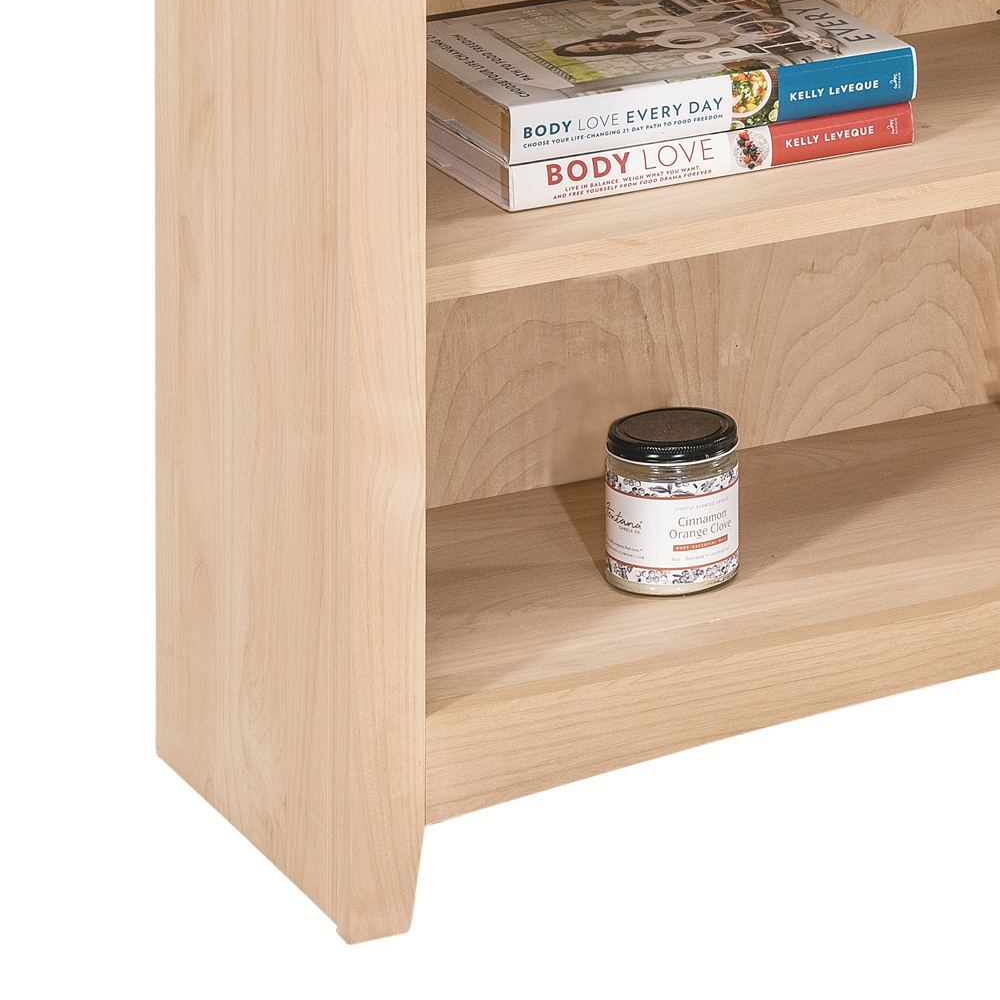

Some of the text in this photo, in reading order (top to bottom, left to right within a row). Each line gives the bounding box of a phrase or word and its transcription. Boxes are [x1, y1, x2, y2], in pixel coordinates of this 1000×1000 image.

[789, 7, 876, 42] EVERY
[431, 39, 530, 97] CHOOSE YOUR LIFE-CHANGING
[451, 34, 534, 81] PATH TO FOOD FREEDOM
[790, 88, 824, 101] KELLY
[523, 97, 723, 139] BODY LOVE EVERY DAY
[523, 140, 550, 149] CHOOSE
[571, 129, 620, 142] LIFE-CHANGING
[622, 126, 644, 134] 21-DAY
[674, 118, 692, 126] FOOD
[694, 114, 723, 123] FREEDOM
[786, 135, 819, 148] KELLY
[546, 138, 715, 186] BODY LOVE
[565, 184, 579, 192] LIVE
[590, 178, 620, 188] BALANCE,
[622, 174, 644, 182] WEIGH
[681, 165, 701, 173] WANT.
[586, 185, 618, 194] YOURSELF
[620, 181, 637, 189] FROM
[639, 178, 658, 186] FOOD
[660, 174, 682, 183] DRAMA
[684, 169, 712, 179] FOREVER
[669, 520, 732, 539] Orange Clove
[678, 510, 726, 526] Cinnamon
